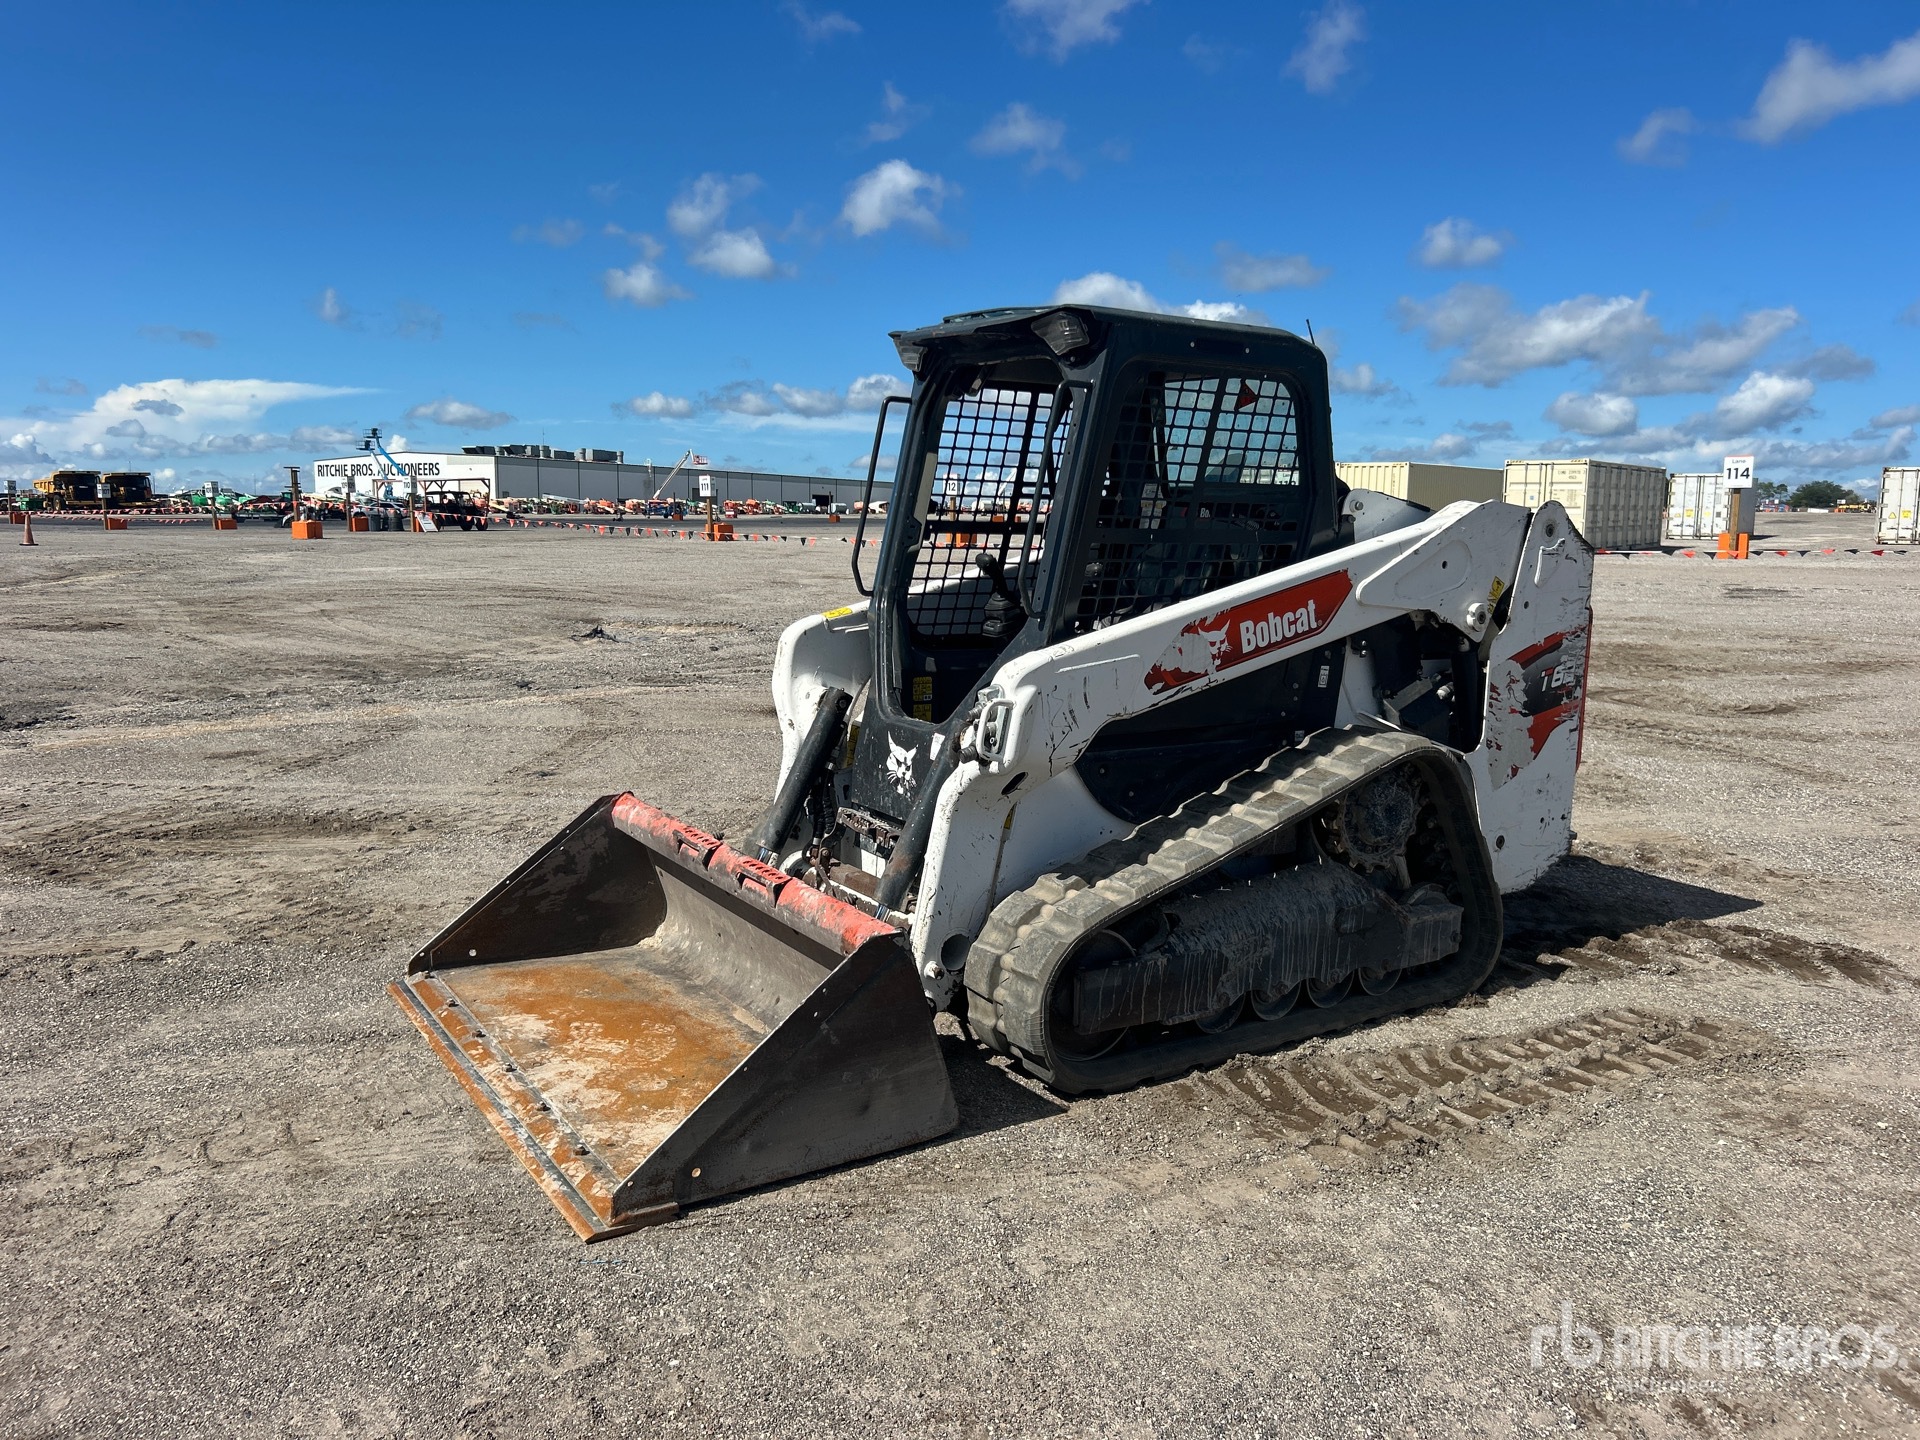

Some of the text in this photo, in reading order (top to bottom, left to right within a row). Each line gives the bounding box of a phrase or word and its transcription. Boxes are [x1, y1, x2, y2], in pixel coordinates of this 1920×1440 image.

[317, 464, 348, 477] RITCHIE
[351, 463, 375, 477] BROS.
[1726, 467, 1750, 480] 114
[700, 482, 708, 491] 111
[945, 482, 956, 491] 12
[1240, 599, 1317, 654] Bobcat
